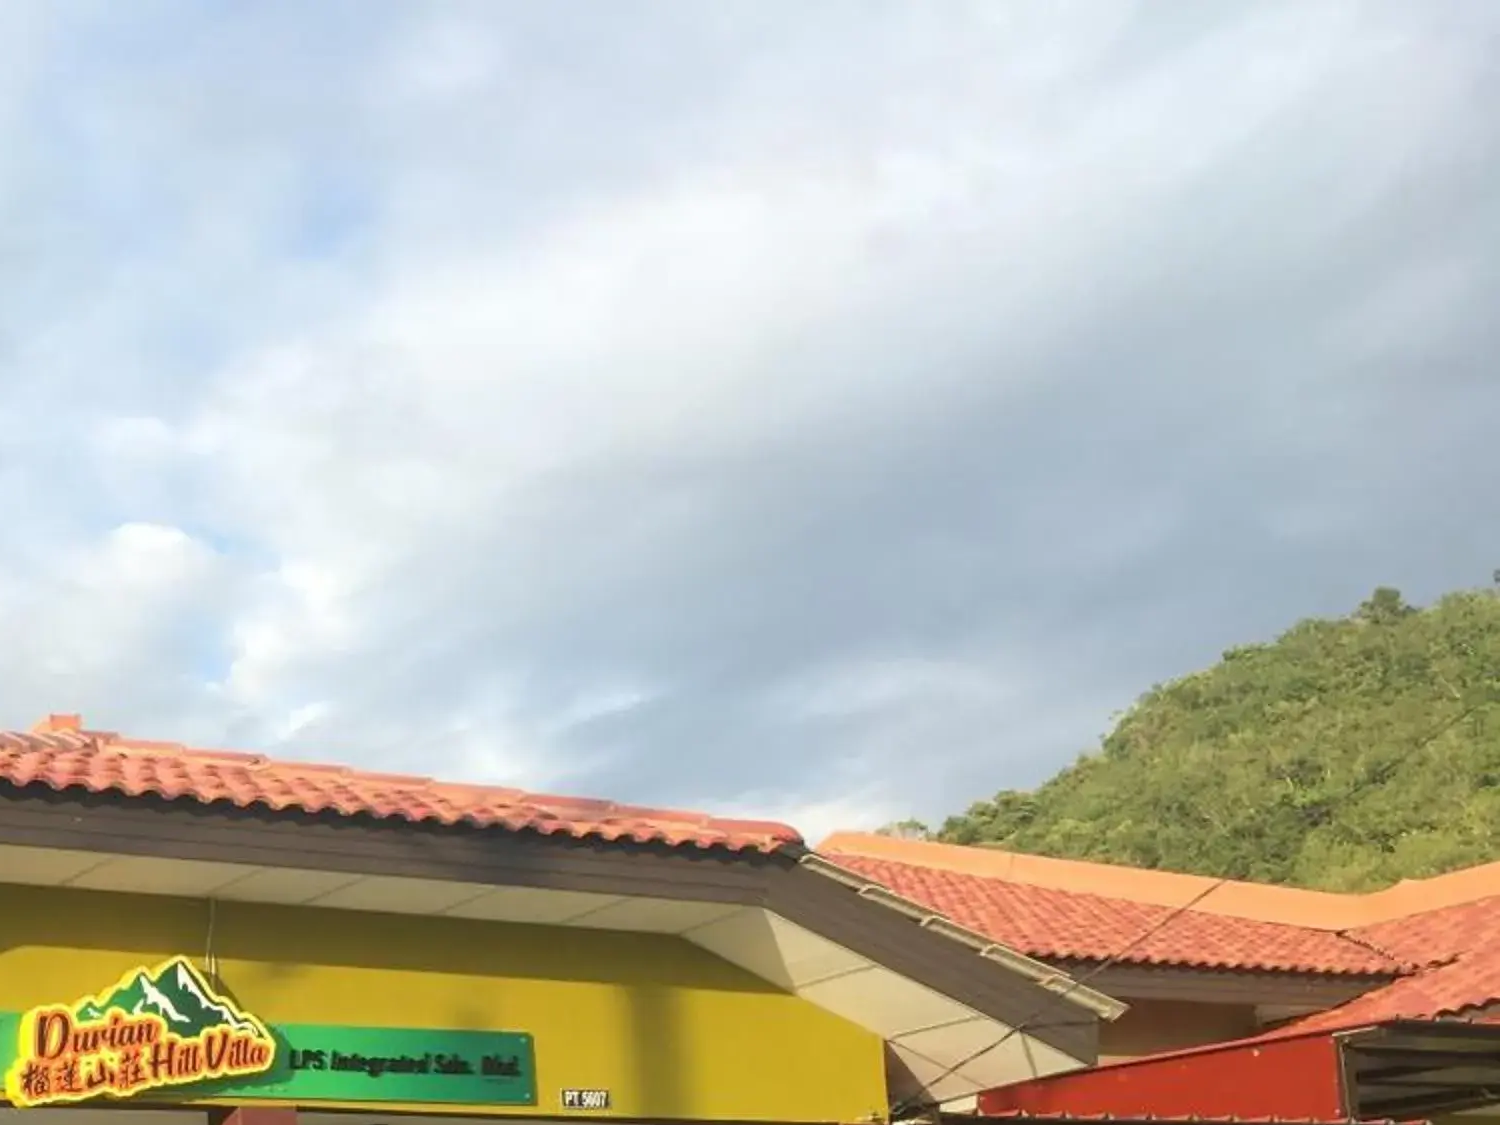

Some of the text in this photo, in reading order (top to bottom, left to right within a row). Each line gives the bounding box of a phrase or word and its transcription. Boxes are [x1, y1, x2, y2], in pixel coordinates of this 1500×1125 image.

[37, 1012, 156, 1059] Durian
[150, 1032, 267, 1078] Hill Villa
[565, 1091, 580, 1106] PT
